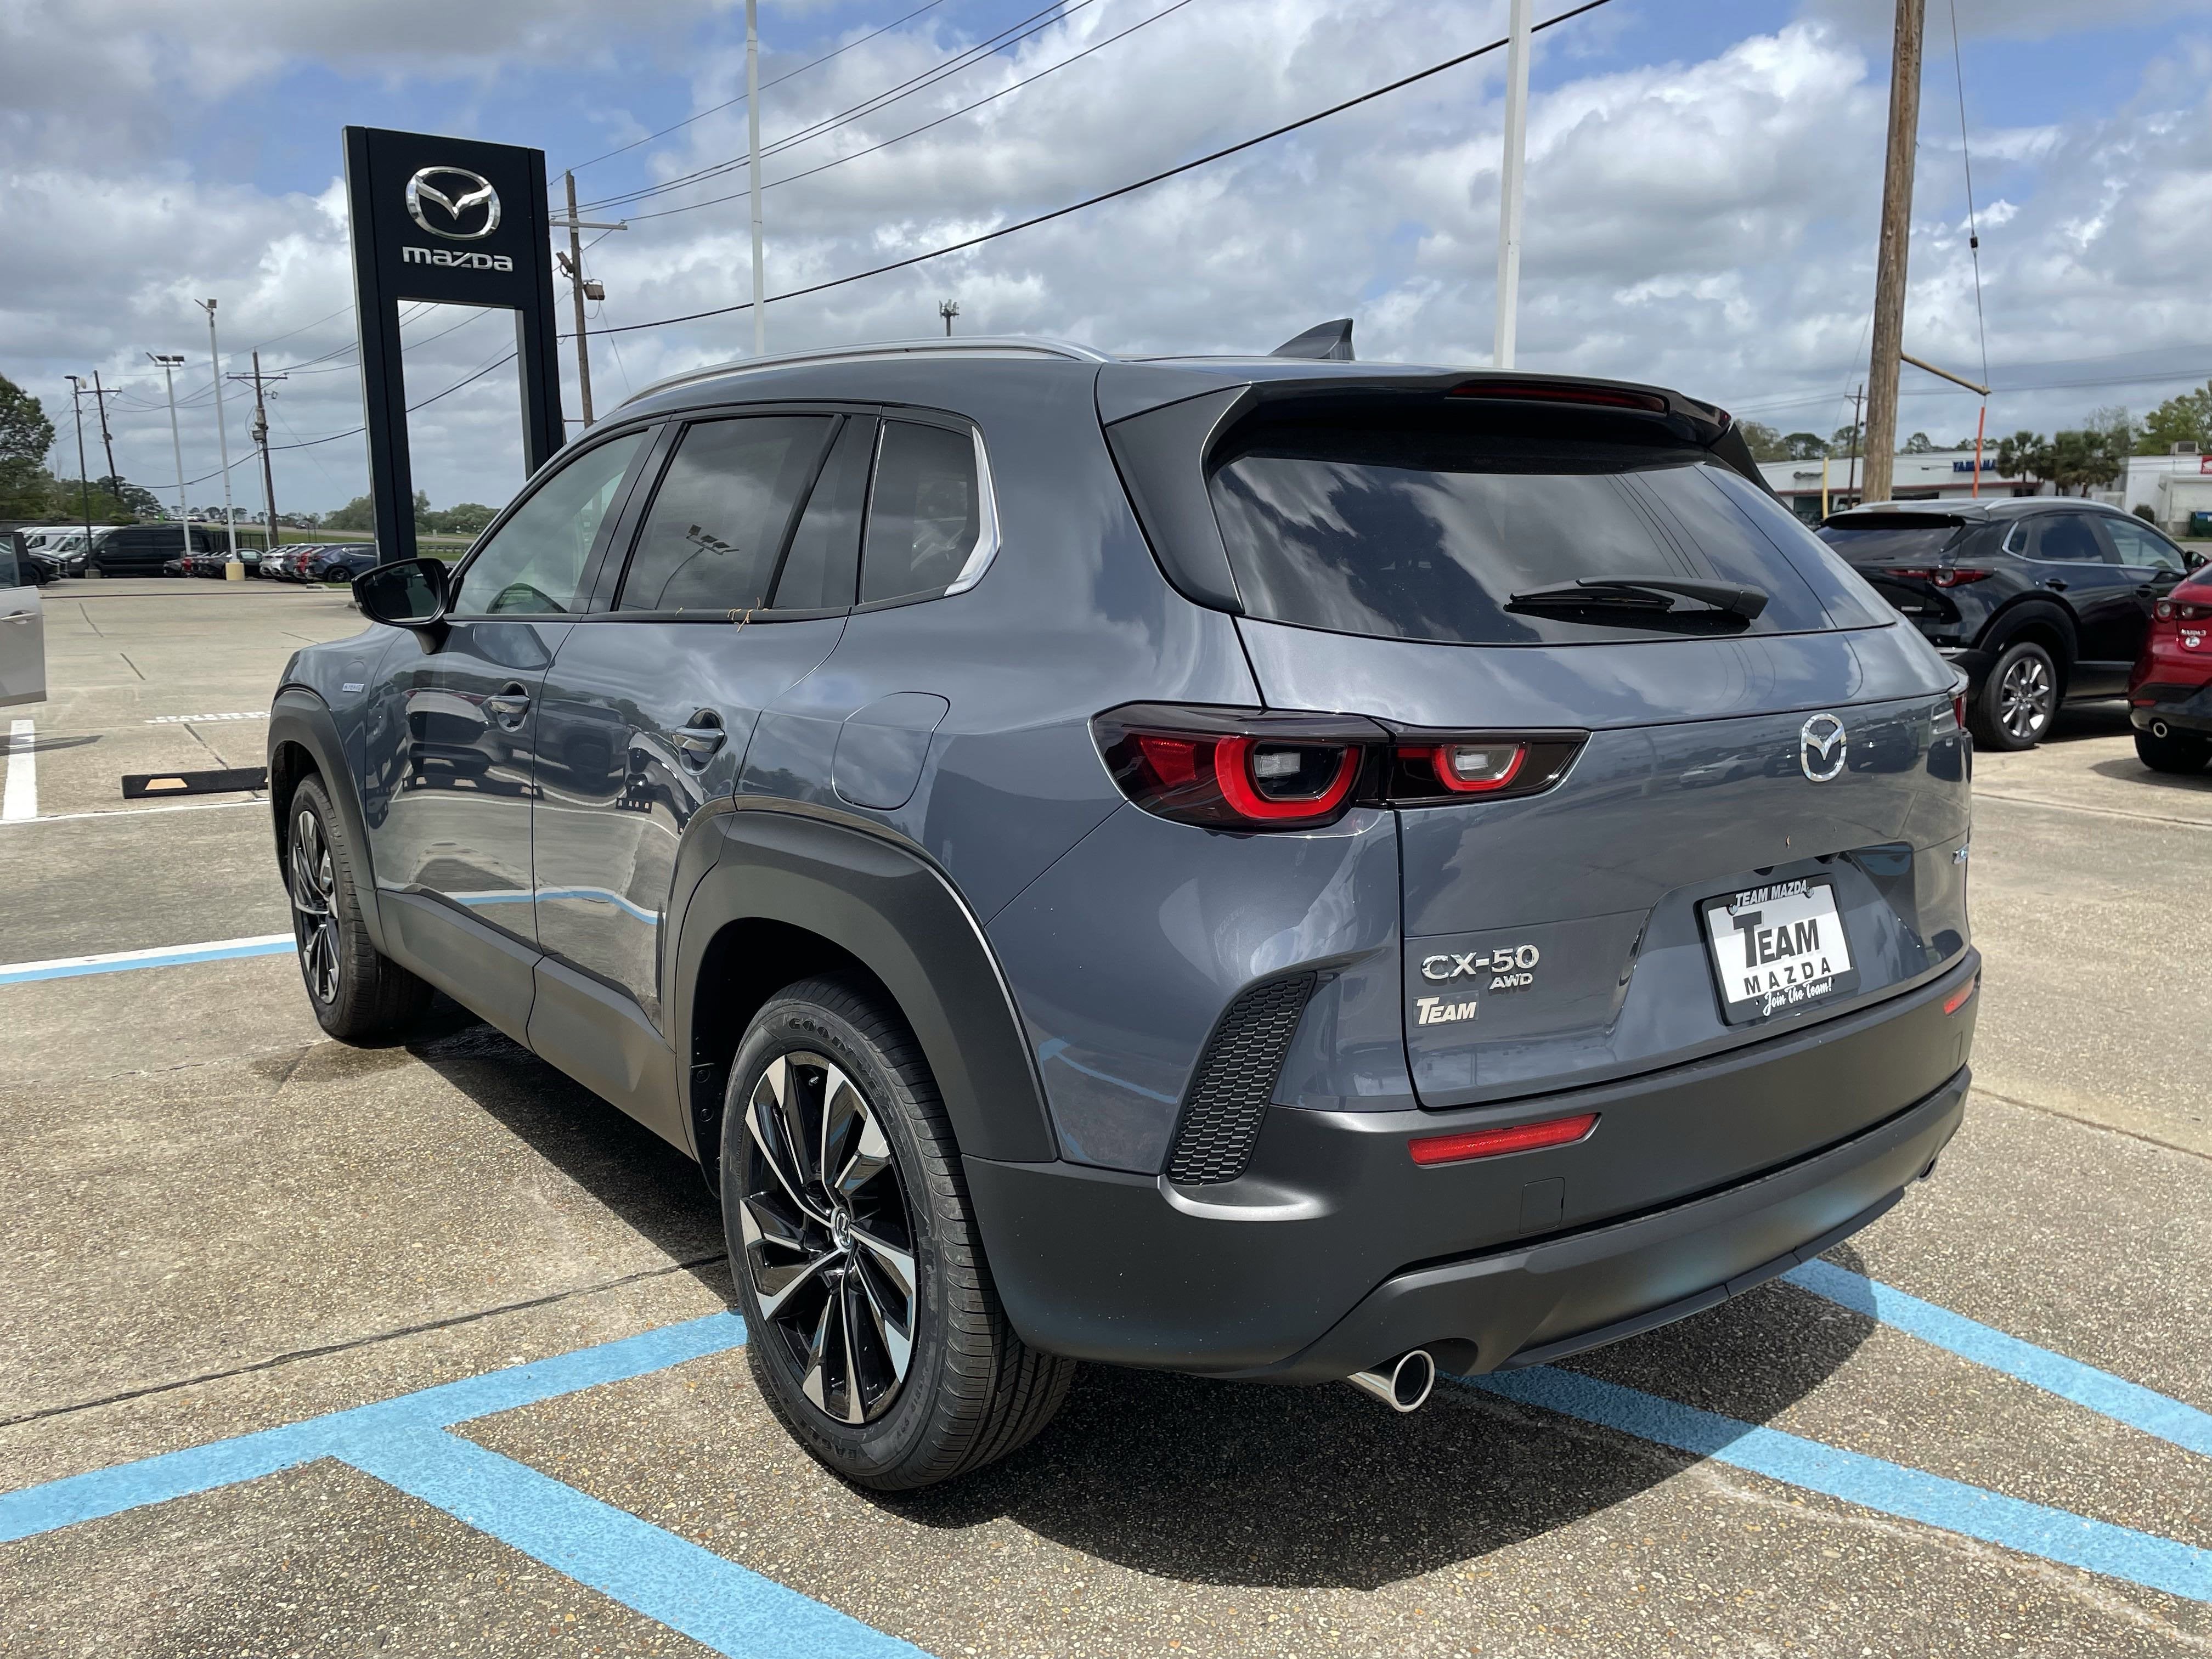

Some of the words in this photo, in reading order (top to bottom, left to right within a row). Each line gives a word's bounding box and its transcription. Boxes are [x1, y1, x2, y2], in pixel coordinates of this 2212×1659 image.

[1735, 887, 1768, 907] TEAM
[1771, 879, 1807, 900] MAZDA
[1733, 910, 1820, 968] TEAM
[1421, 944, 1540, 980] CX-50
[1743, 957, 1831, 996] MAZDA
[1489, 972, 1533, 990] AWD
[1763, 991, 1786, 1016] Join
[1784, 985, 1804, 1003] The
[1802, 977, 1832, 998] Team!
[1417, 996, 1477, 1025] TEAM
[788, 1018, 907, 1159] GOODYEAR
